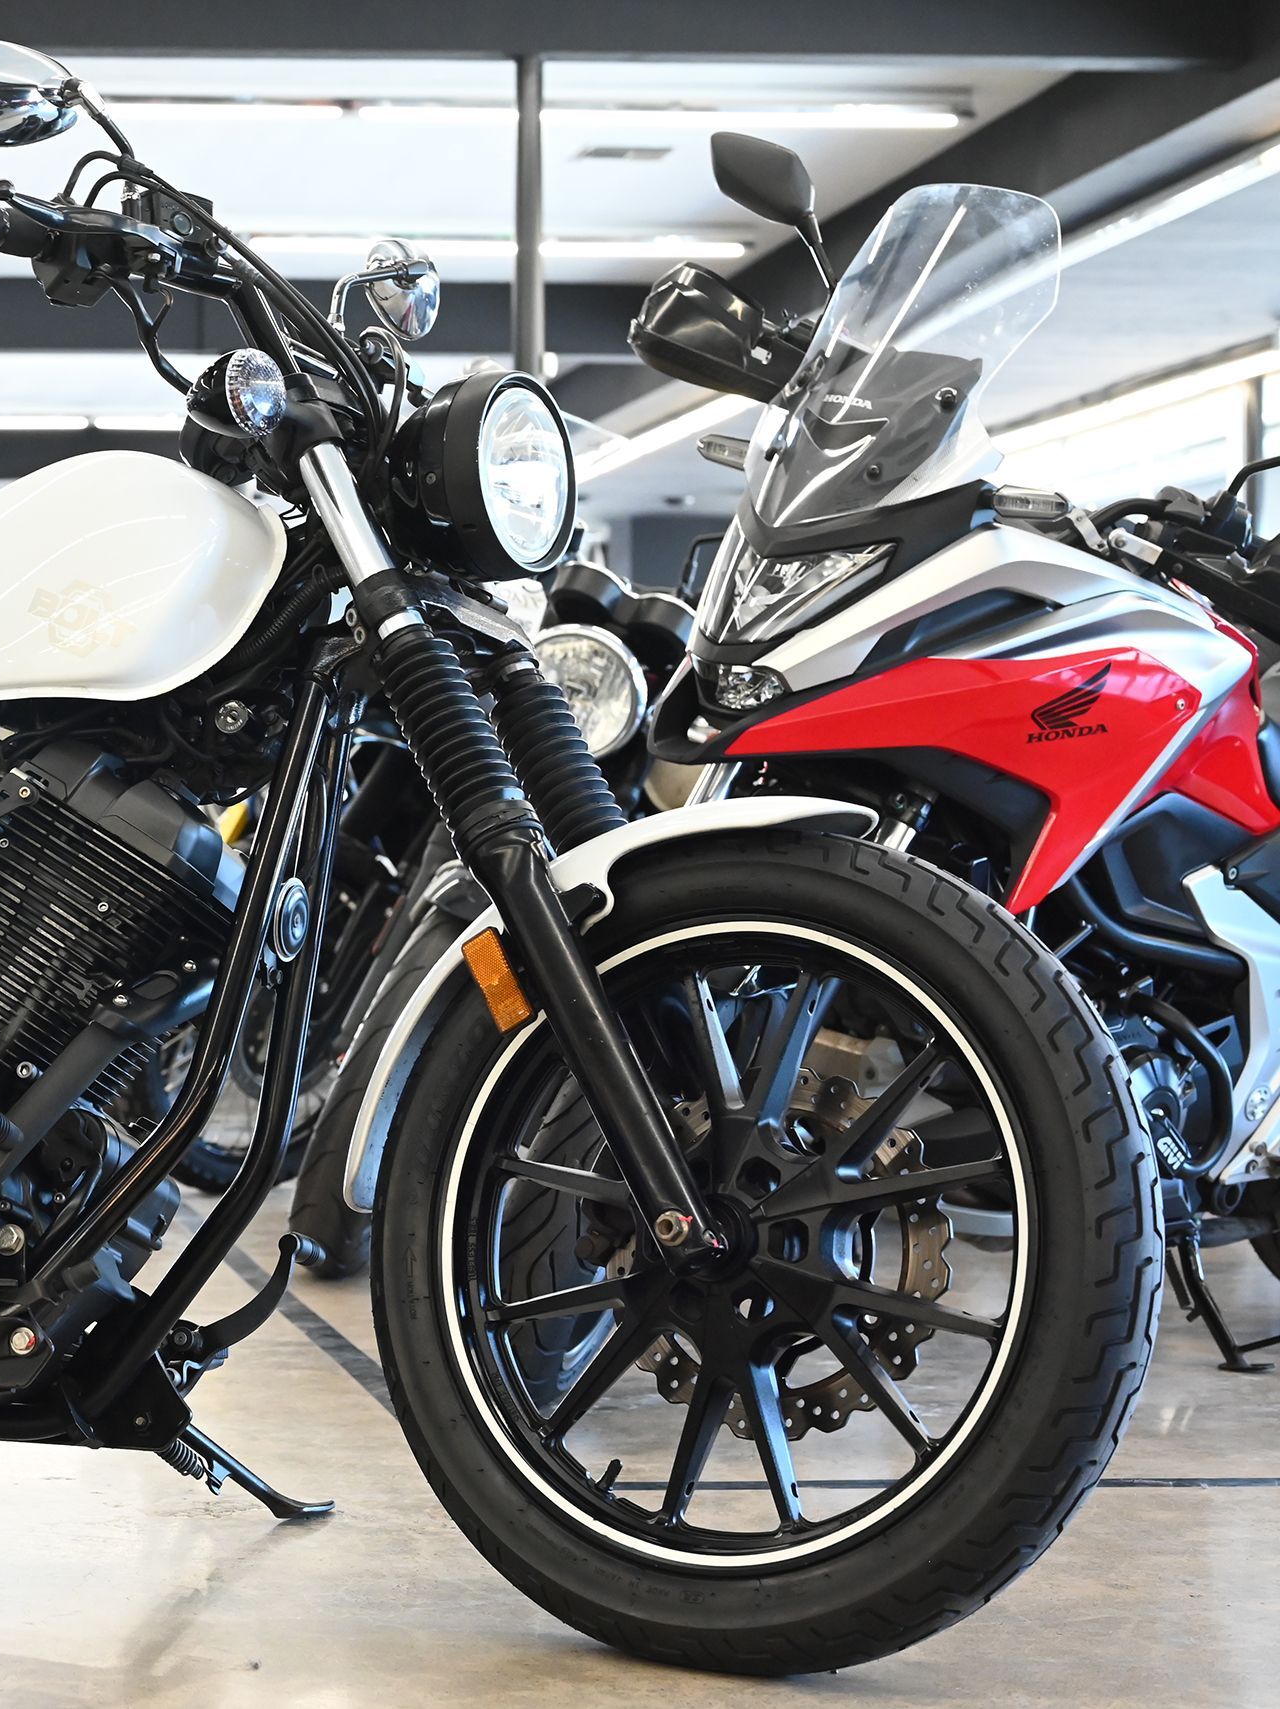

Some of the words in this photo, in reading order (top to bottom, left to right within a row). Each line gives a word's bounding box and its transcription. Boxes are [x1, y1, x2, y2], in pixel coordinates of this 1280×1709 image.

[823, 394, 873, 410] HONDA
[1026, 723, 1108, 744] HONDA
[1156, 1135, 1186, 1171] GIVI
